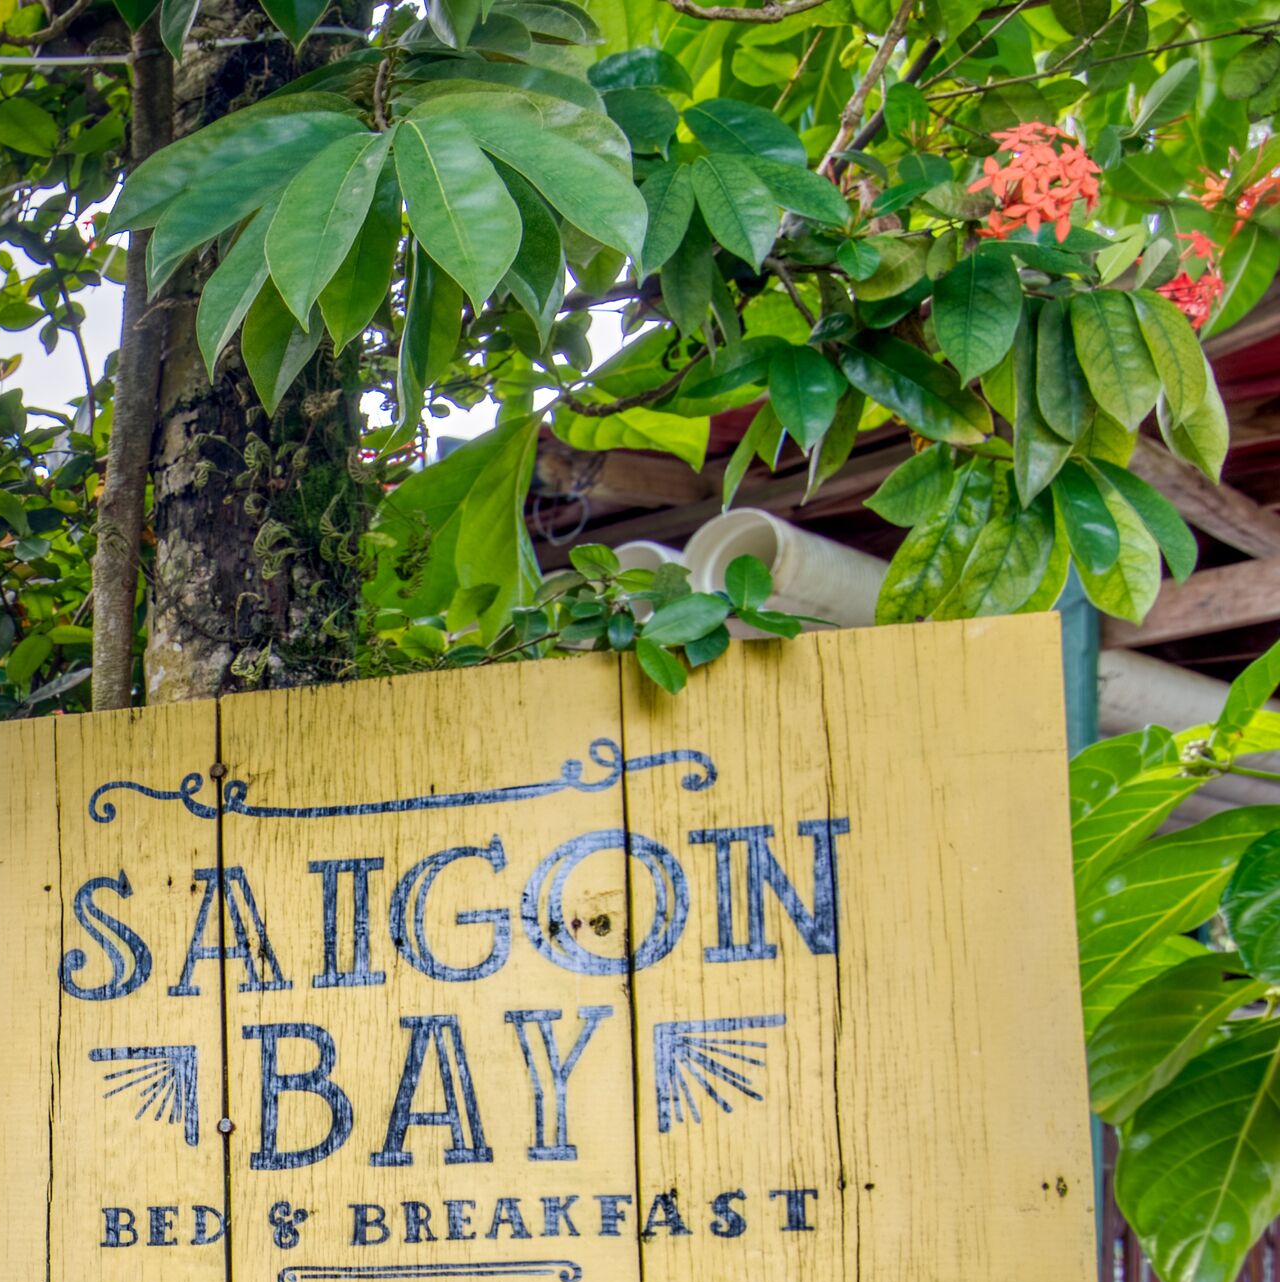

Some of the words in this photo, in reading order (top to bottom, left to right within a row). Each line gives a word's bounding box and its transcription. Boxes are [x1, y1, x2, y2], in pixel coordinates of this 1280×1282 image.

[59, 817, 851, 1001] SAIGON
[241, 1005, 614, 1171] BAY
[99, 1204, 230, 1249] BED
[268, 1200, 308, 1249] &
[348, 1188, 819, 1246] BREAKFAST
